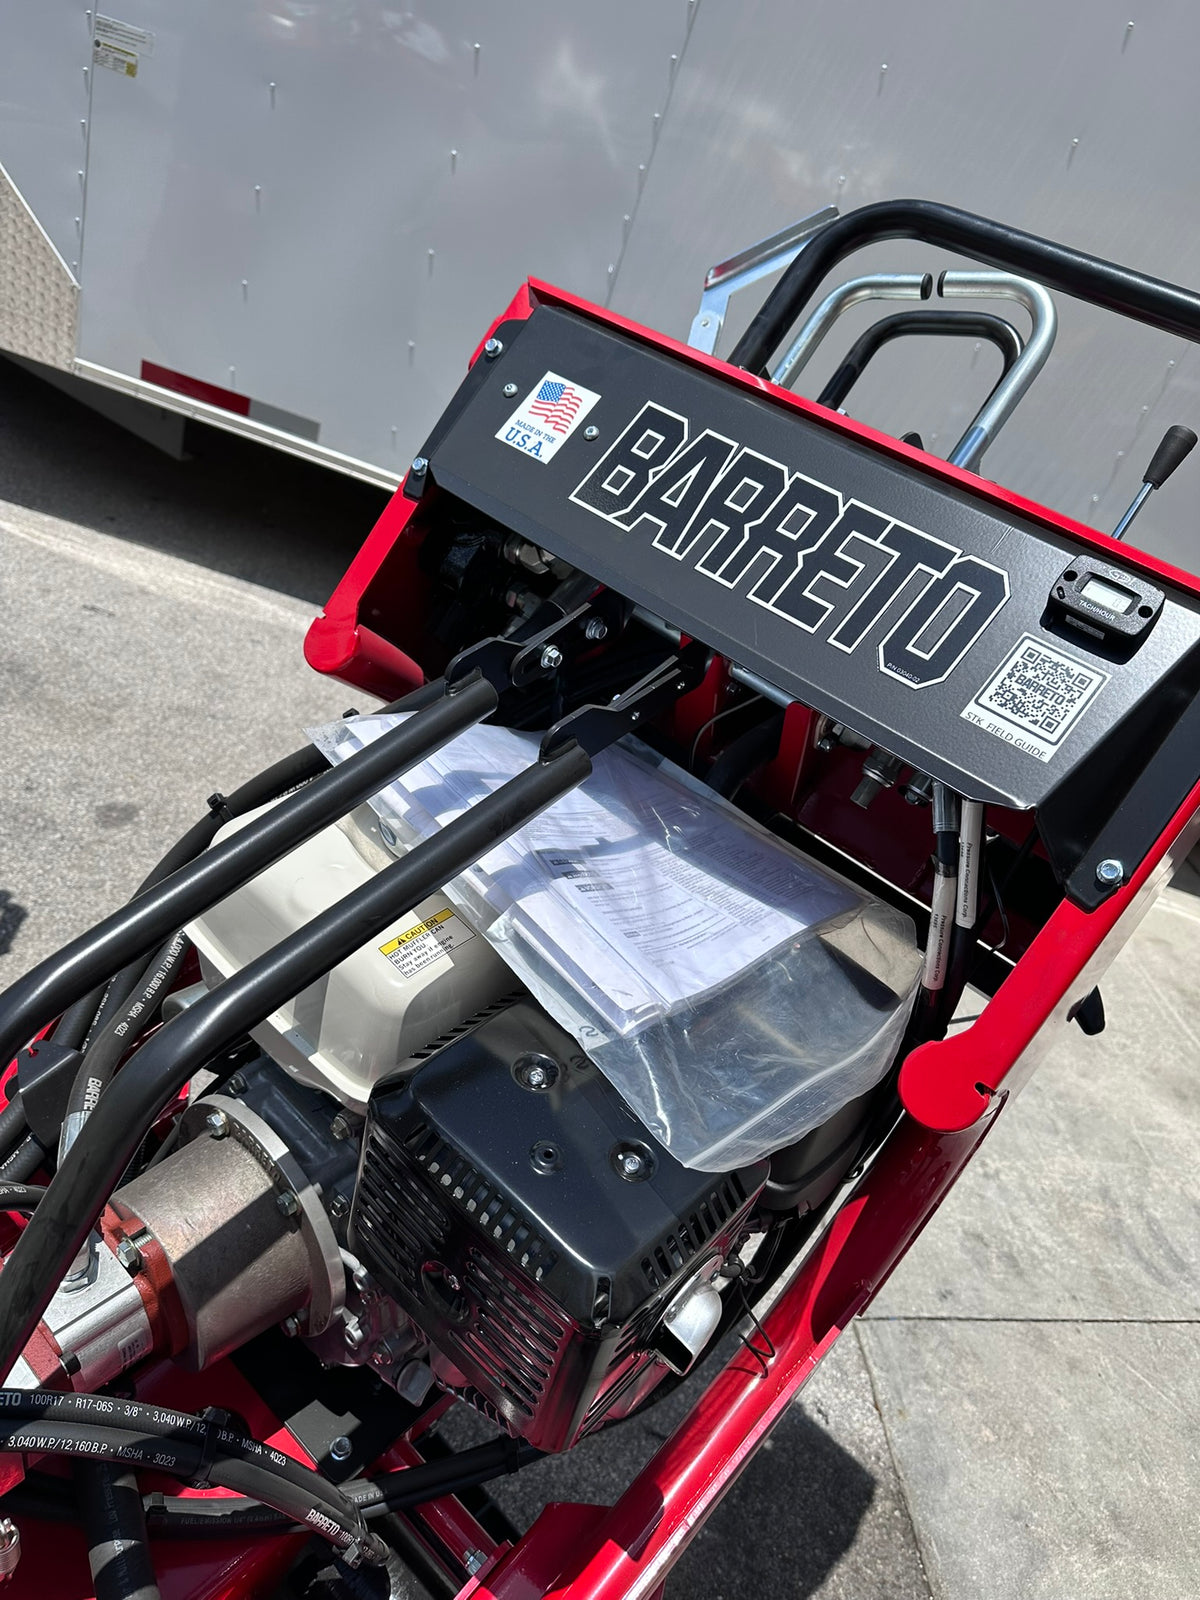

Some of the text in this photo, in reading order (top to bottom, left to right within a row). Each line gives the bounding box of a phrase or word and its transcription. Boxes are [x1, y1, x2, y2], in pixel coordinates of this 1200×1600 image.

[505, 427, 543, 457] U.S.A.
[515, 420, 556, 444] MADE IN THE
[568, 400, 1011, 690] BARRETO
[1079, 600, 1116, 621] TACH/HOUR
[1015, 674, 1065, 705] BARRETO
[965, 711, 1047, 759] STK FIELD GUIDE
[389, 925, 444, 960] HOT MUFFLER CAN
[405, 918, 438, 941] CAUTION
[394, 951, 413, 965] BURN
[399, 959, 413, 970] Stay
[413, 951, 428, 963] away
[434, 935, 453, 949] engine
[404, 966, 416, 976] has
[415, 957, 430, 969] been
[127, 1001, 145, 1018] MSHA
[84, 1077, 103, 1111] BARRE
[30, 1394, 64, 1406] 100R17
[75, 1397, 114, 1413] R17-06S
[124, 1405, 143, 1417] 3/8"
[241, 1437, 262, 1455] MSHA
[116, 1446, 144, 1459] MSHA
[354, 1494, 366, 1503] ADE
[305, 1508, 341, 1536] BARRETO
